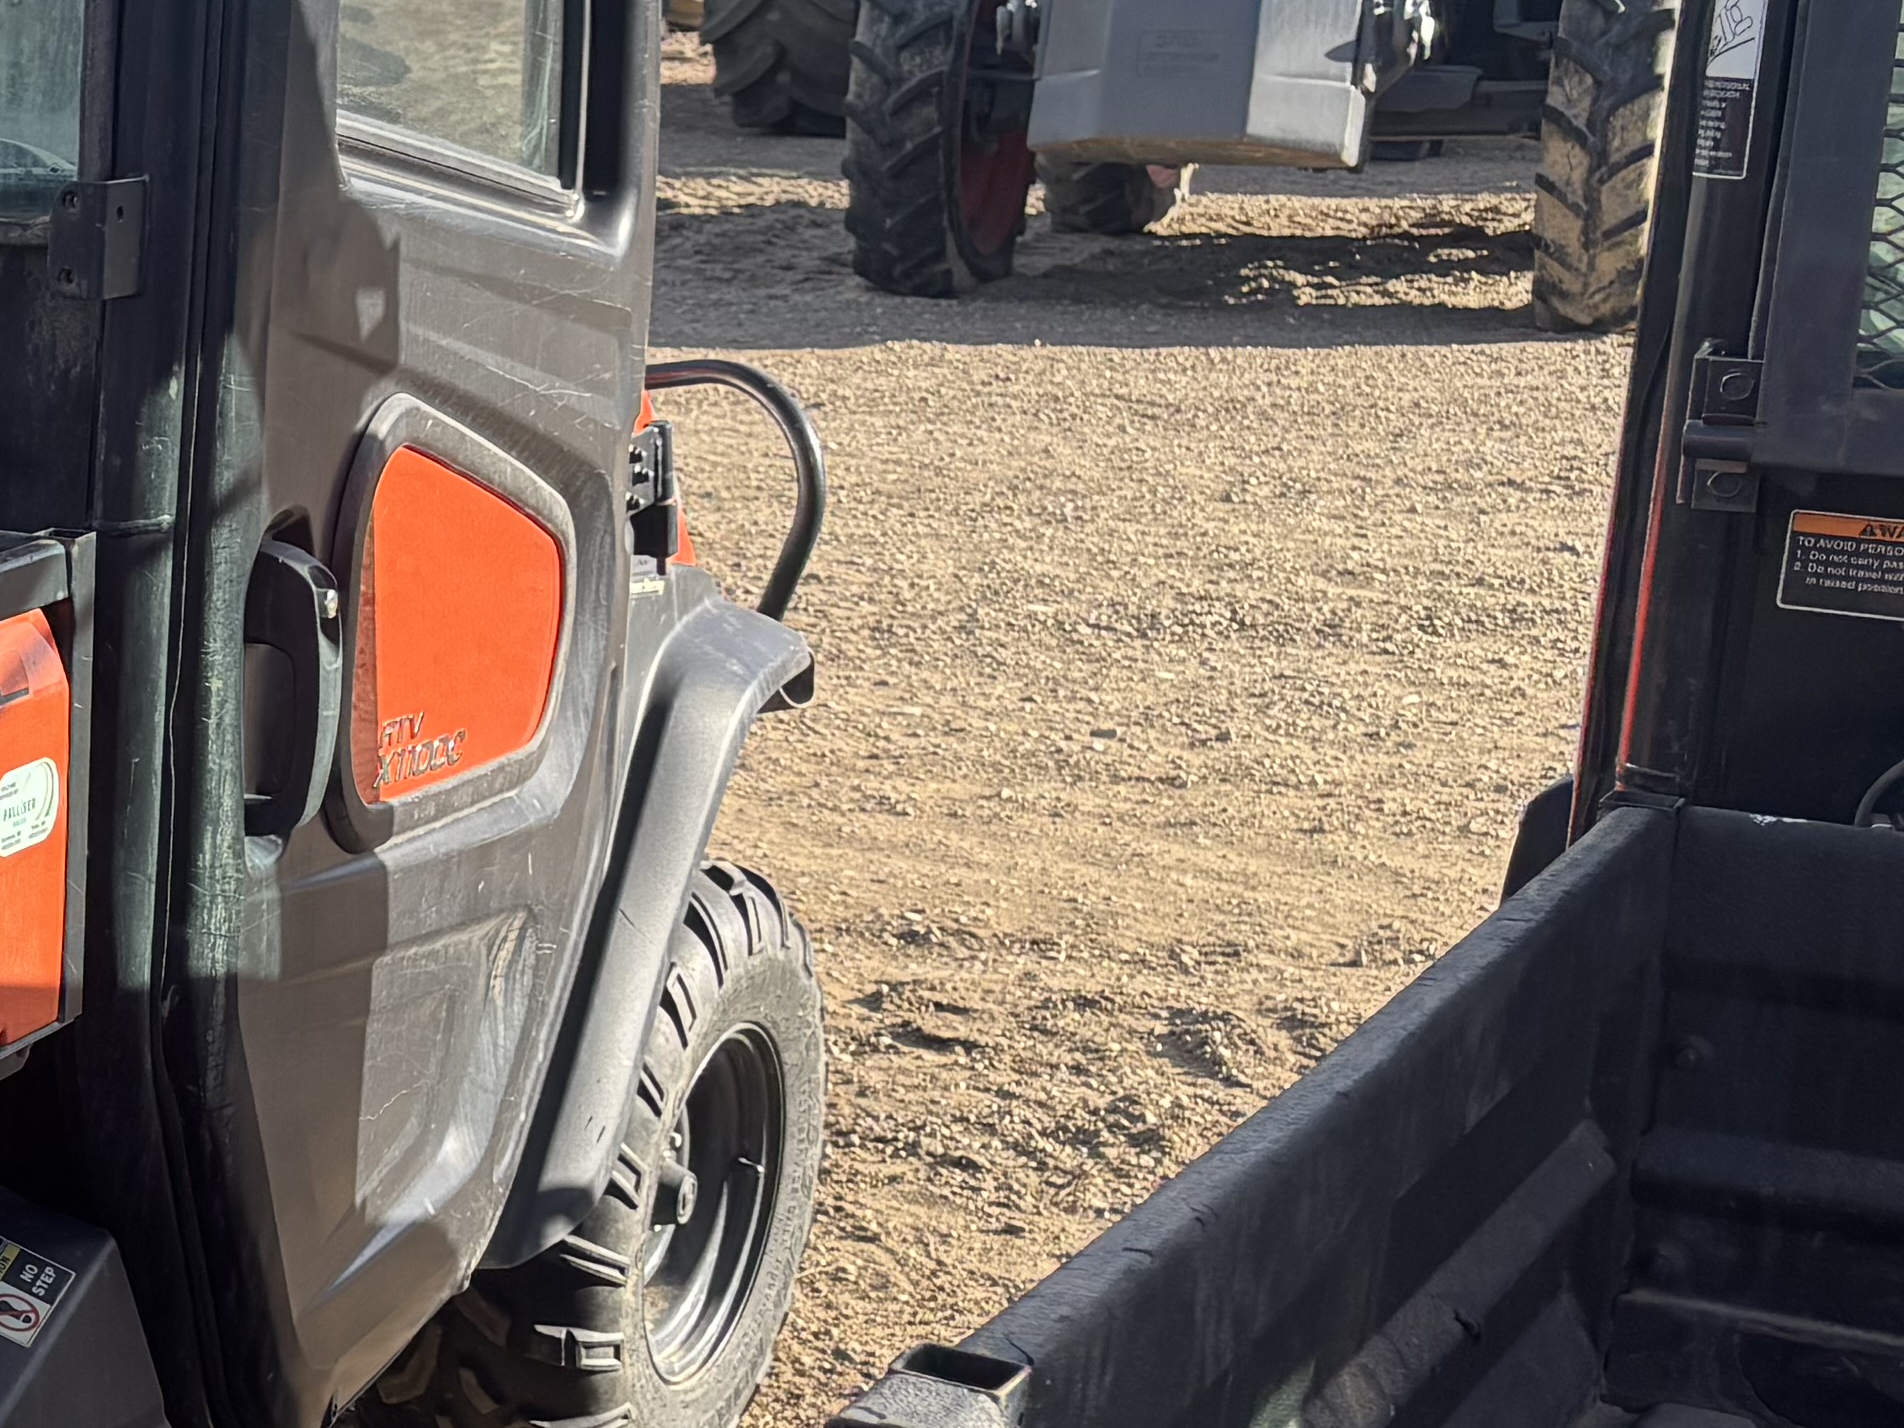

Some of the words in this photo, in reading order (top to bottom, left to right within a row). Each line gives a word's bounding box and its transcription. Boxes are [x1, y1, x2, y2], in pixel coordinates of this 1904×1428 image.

[1796, 536, 1815, 547] TO
[1816, 538, 1856, 552] AVOID
[1859, 542, 1904, 556] PERSO
[1809, 550, 1826, 561] Do
[1827, 565, 1845, 576] not
[19, 1263, 39, 1283] NO
[31, 1265, 57, 1297] STEP
